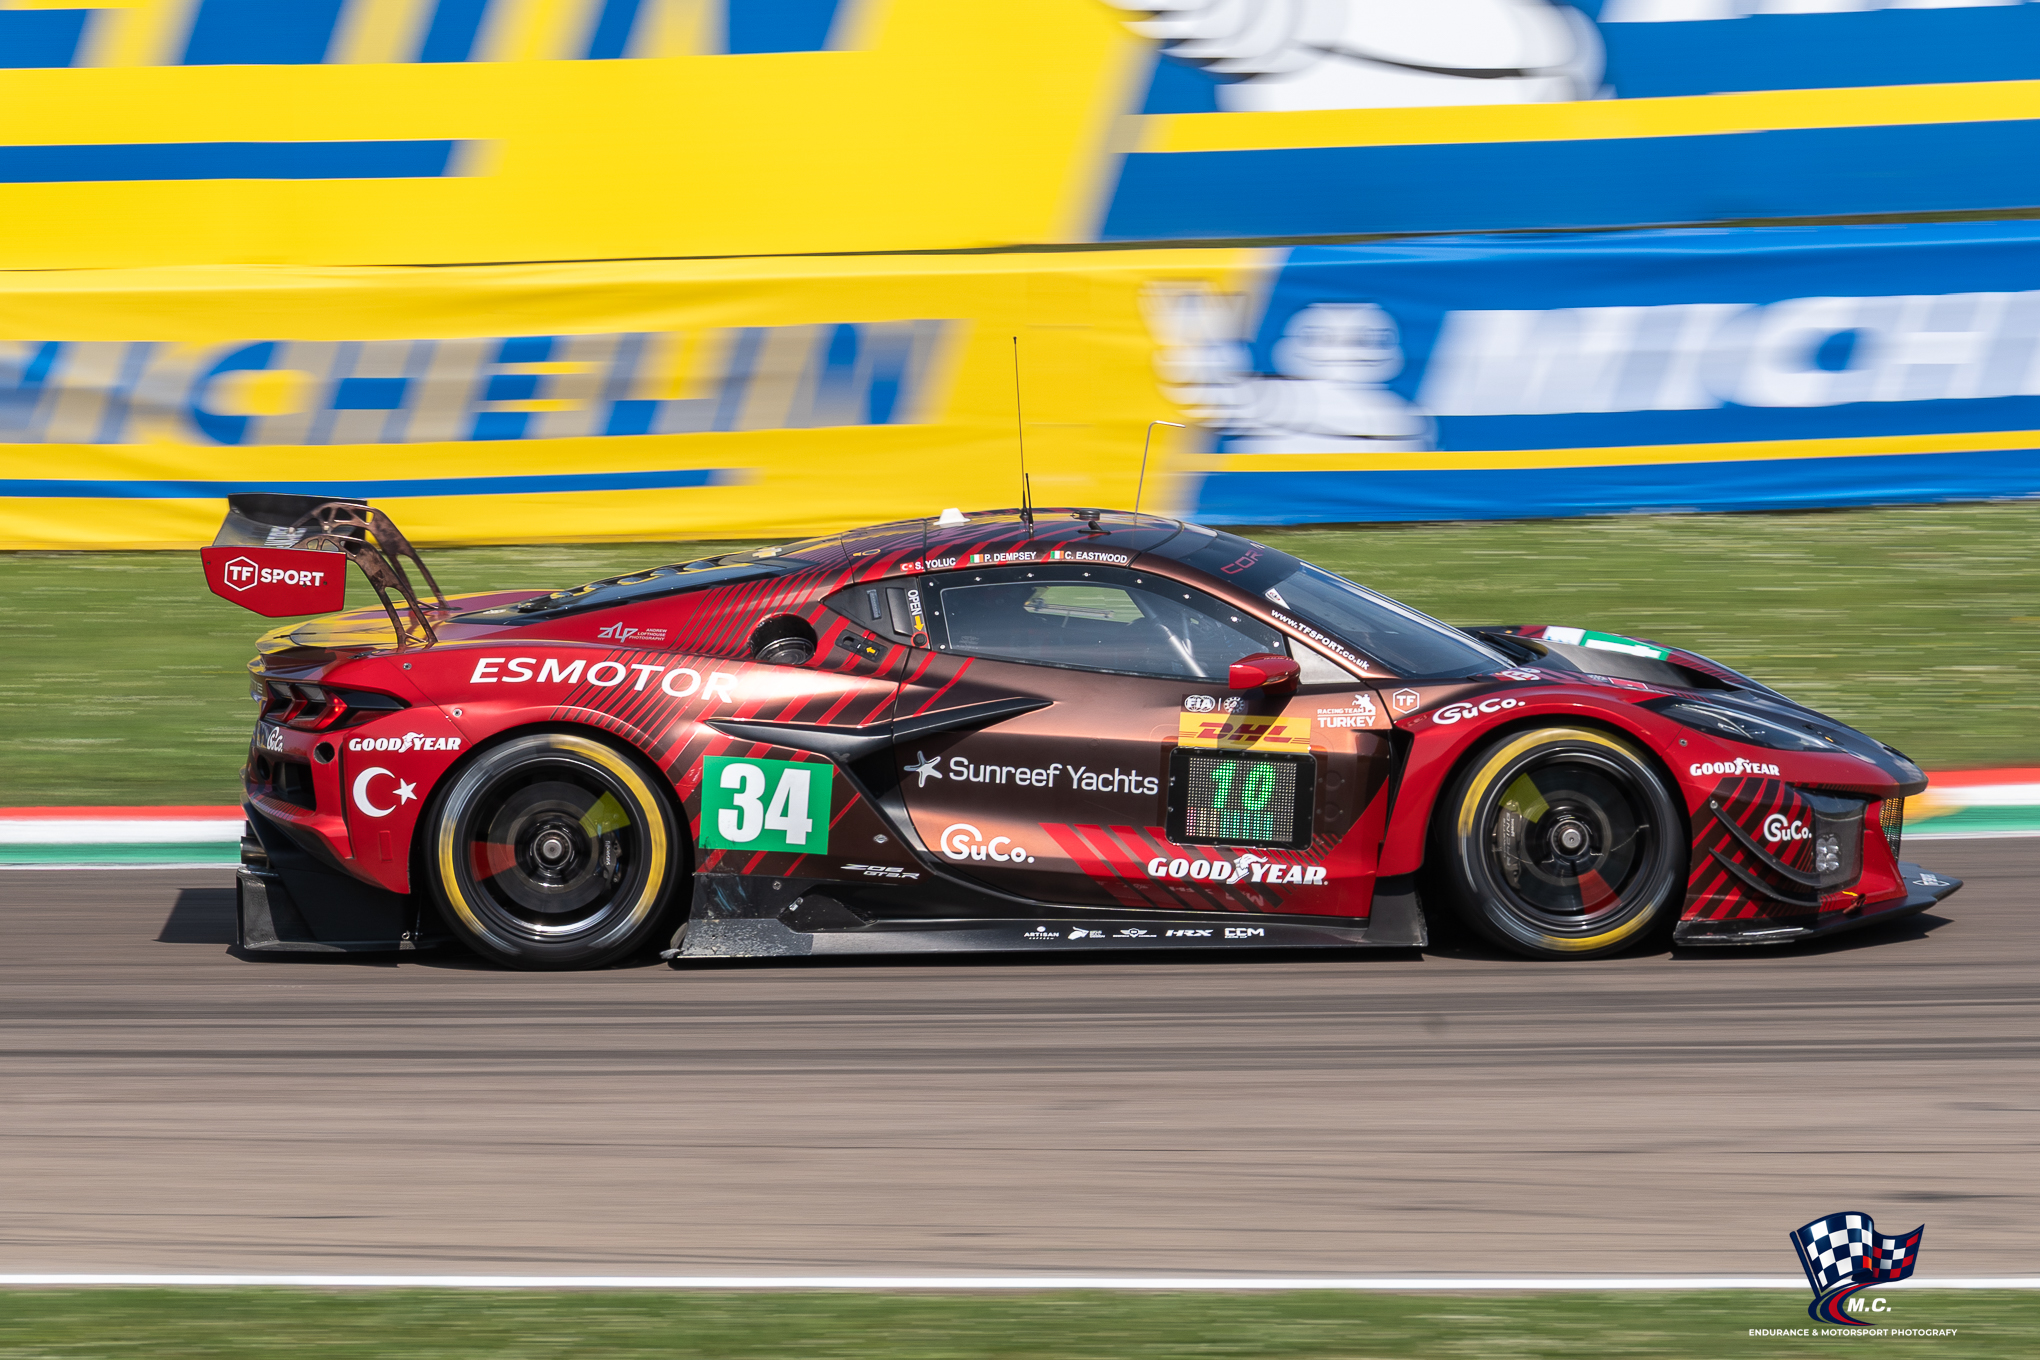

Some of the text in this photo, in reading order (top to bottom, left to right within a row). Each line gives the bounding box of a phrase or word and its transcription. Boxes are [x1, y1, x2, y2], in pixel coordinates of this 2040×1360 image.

[1408, 290, 2040, 417] MICH
[915, 558, 956, 570] S. YOLUC
[984, 551, 1036, 563] P. DEMPSEY
[1064, 551, 1128, 563] C. EASTWOOD
[229, 565, 324, 587] TF SPORT
[907, 589, 922, 616] OPEN
[1271, 609, 1370, 671] www.TFSPORT.co.uk
[469, 657, 738, 704] ESMOTOR
[1186, 696, 1213, 710] FIA
[1343, 707, 1364, 715] TEAM
[1396, 695, 1416, 707] TF
[1196, 721, 1293, 744] DHL
[1317, 716, 1376, 728] TURKEY
[349, 732, 462, 753] GOODYEAR
[949, 756, 1159, 795] Sunreef Yachts
[1689, 757, 1780, 777] GOODYEAR
[1211, 758, 1276, 811] 10
[717, 762, 813, 846] 34
[1147, 853, 1329, 886] GOODYEAR
